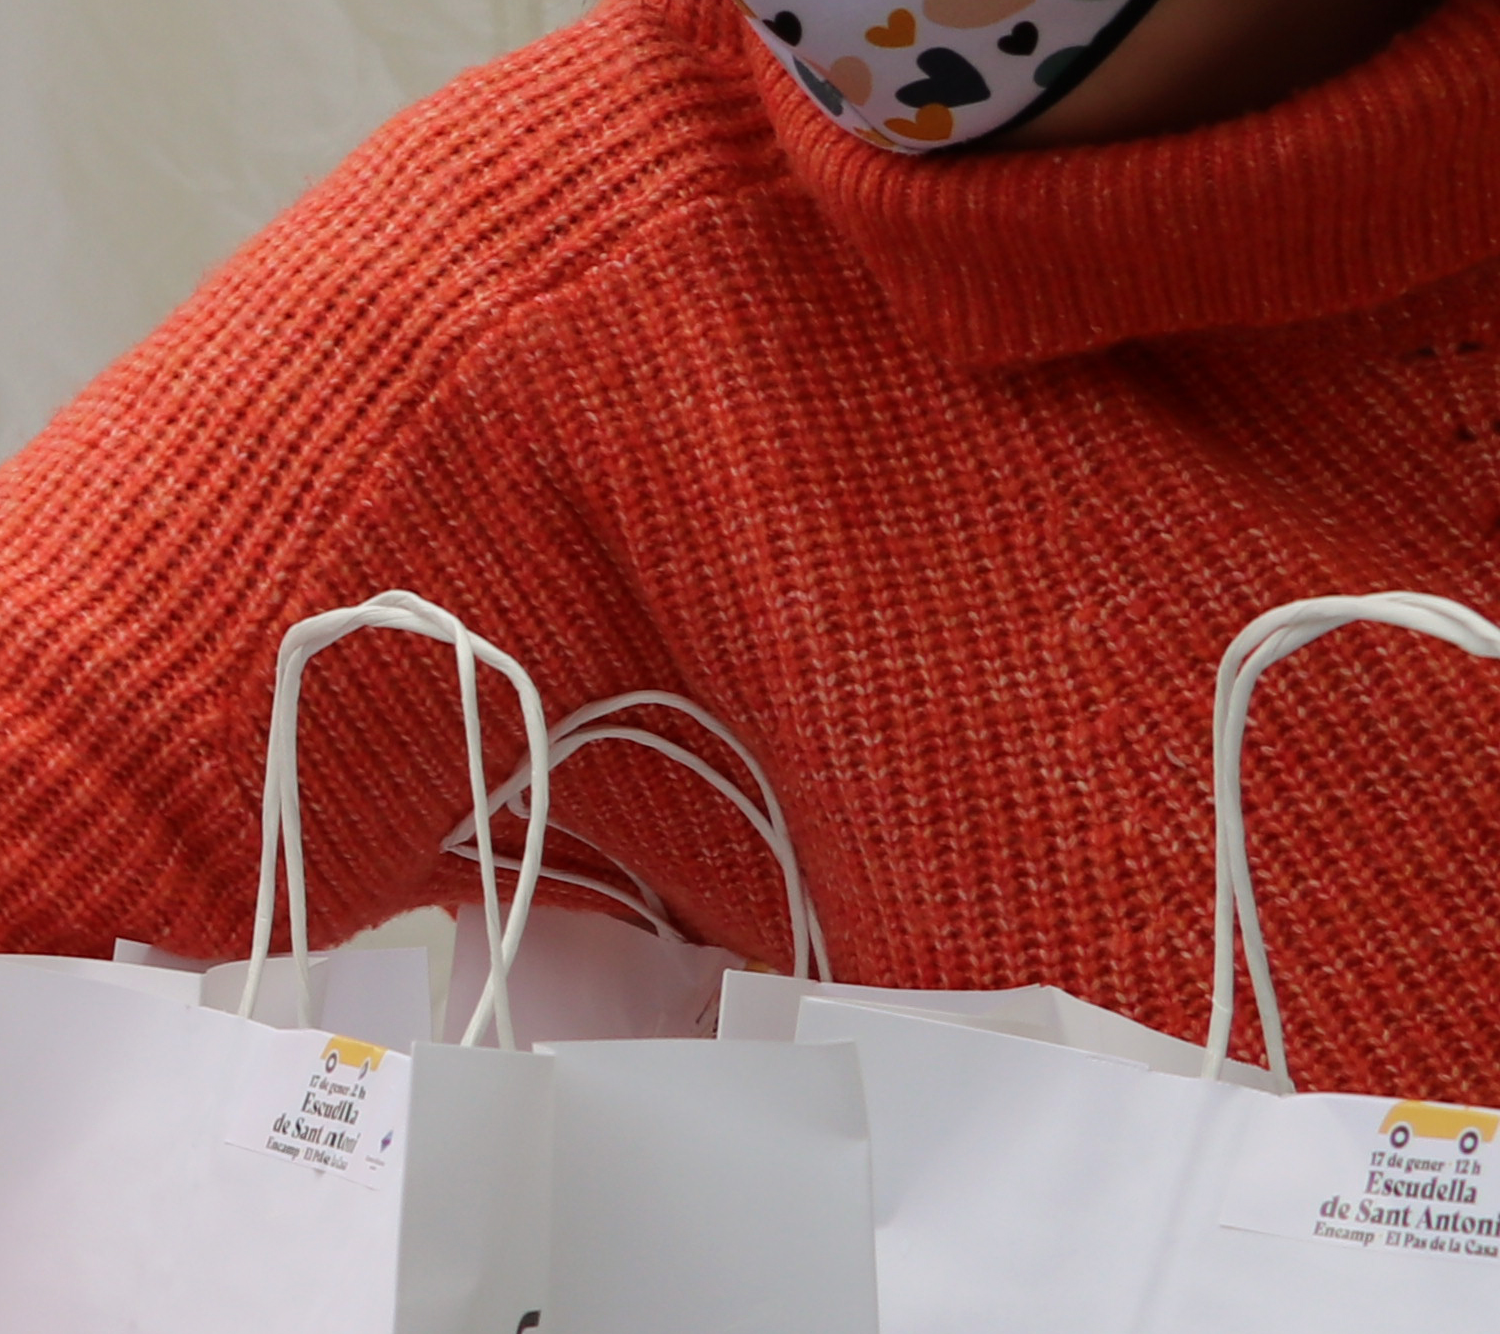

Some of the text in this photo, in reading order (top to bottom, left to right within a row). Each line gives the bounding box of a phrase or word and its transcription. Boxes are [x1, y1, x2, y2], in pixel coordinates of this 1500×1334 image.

[272, 1113, 290, 1135] de
[291, 1117, 323, 1145] Sant
[1370, 1151, 1481, 1176] 17 de gener 12 h
[1365, 1170, 1477, 1205] Escudella
[1319, 1195, 1500, 1238] de Sant Antoni
[1313, 1221, 1499, 1258] Encamp El Pas de la Casa
